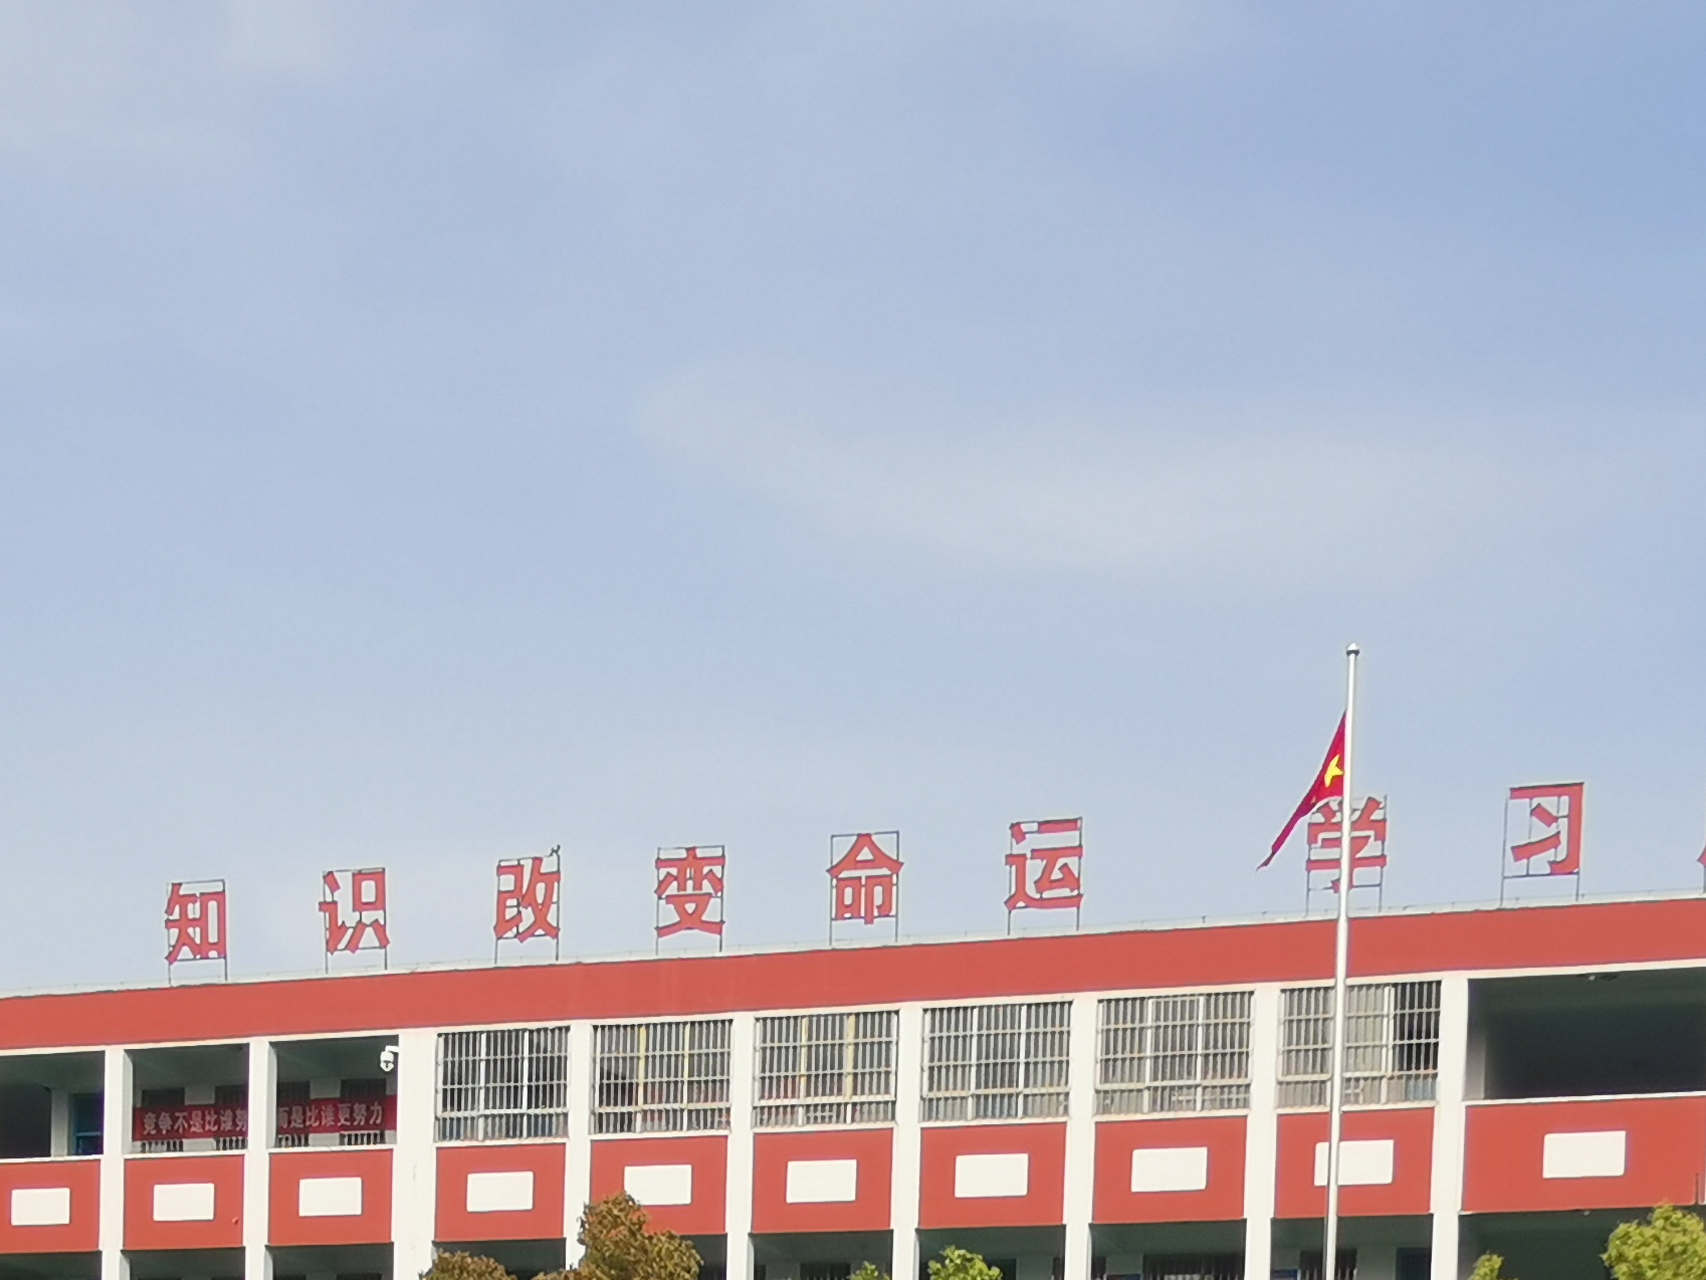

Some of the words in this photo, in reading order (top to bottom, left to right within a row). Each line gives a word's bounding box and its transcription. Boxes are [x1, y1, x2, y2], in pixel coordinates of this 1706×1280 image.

[165, 819, 1083, 965] 知识改变命运
